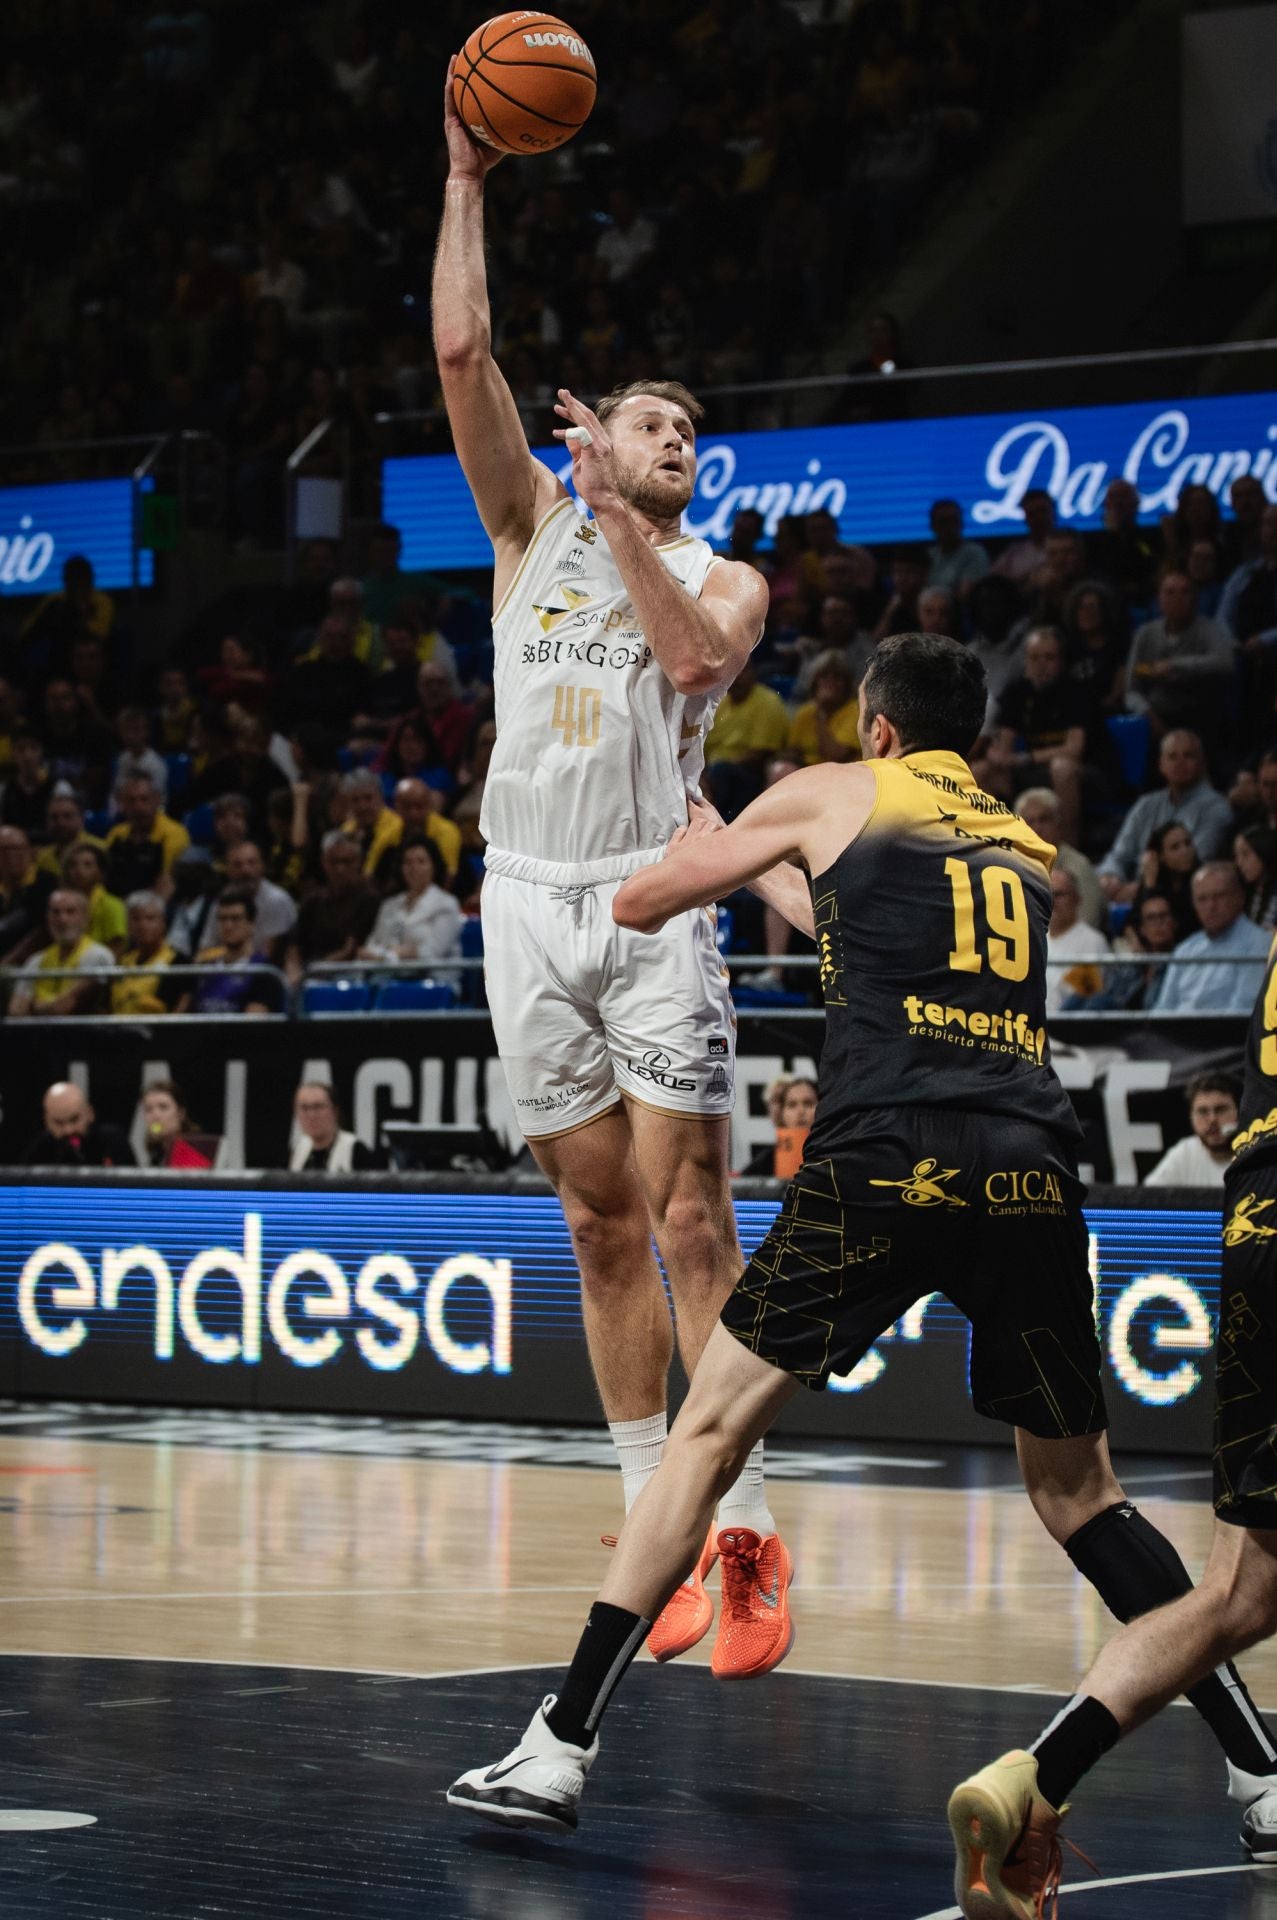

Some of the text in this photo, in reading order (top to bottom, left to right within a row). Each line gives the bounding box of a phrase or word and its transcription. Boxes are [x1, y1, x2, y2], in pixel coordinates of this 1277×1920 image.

[971, 421, 1107, 524] Da
[552, 685, 603, 747] 40
[944, 857, 1030, 982] 19
[909, 1025, 975, 1047] despierta
[627, 1059, 697, 1091] LEXUS
[517, 1096, 554, 1106] CASTILLA
[557, 1092, 563, 1100] Y
[988, 1204, 1027, 1217] Canary
[18, 1212, 514, 1376] endesa
